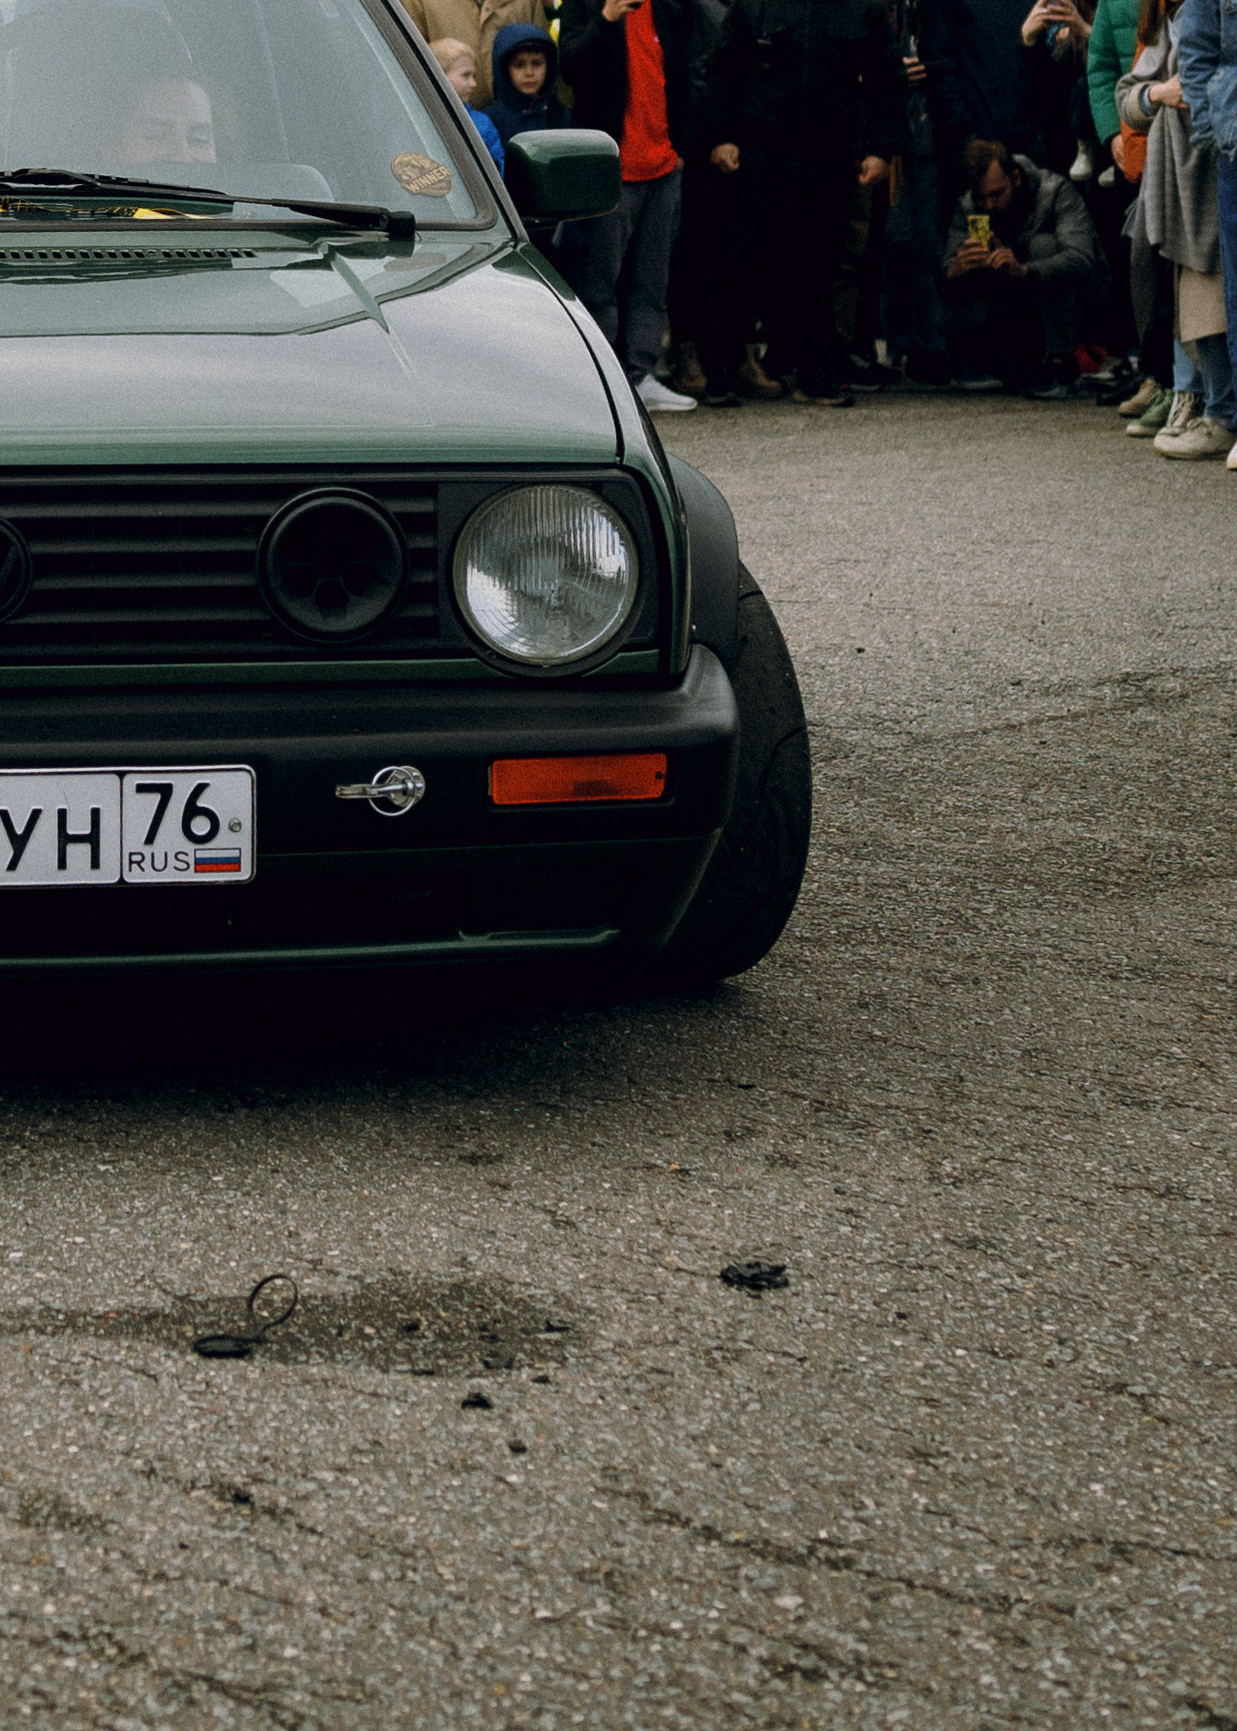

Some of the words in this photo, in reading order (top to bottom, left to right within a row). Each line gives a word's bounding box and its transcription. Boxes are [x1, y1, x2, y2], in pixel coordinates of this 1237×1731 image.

[404, 166, 451, 193] WINNER
[135, 782, 220, 845] 76
[129, 851, 190, 872] RUS
